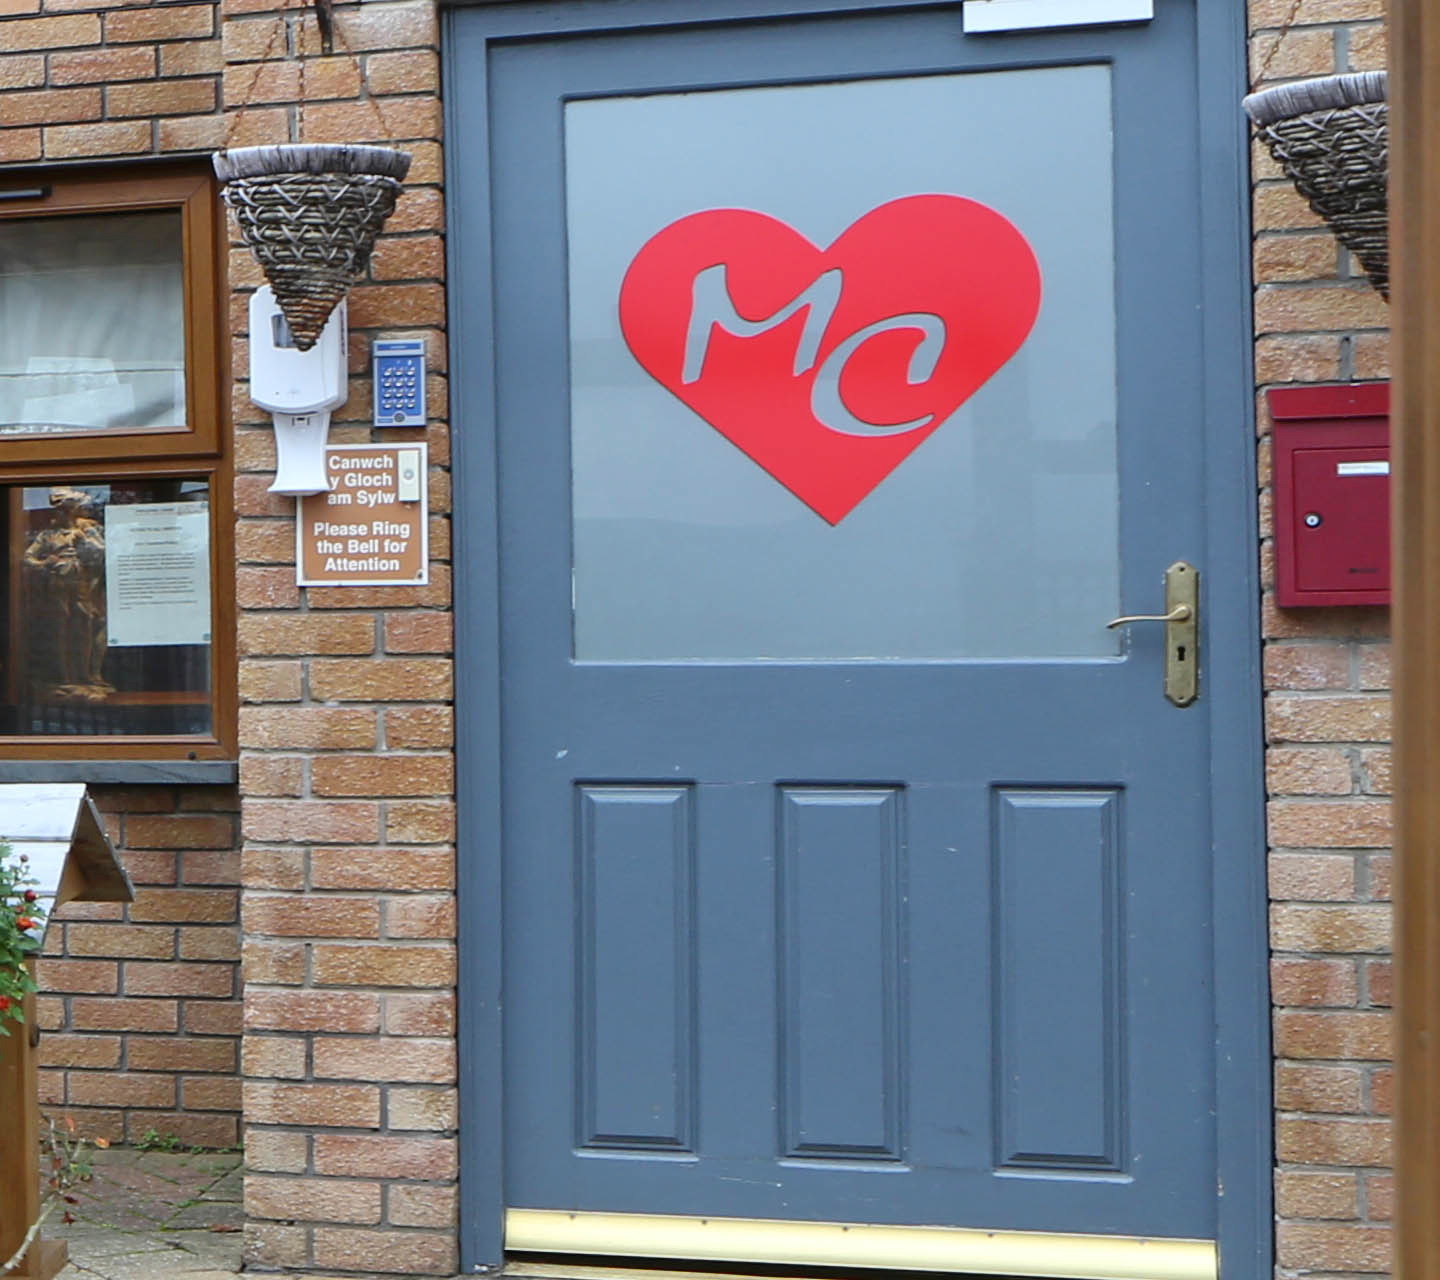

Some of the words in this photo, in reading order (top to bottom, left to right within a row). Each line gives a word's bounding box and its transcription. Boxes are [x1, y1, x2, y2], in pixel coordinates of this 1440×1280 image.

[328, 455, 393, 469] Canwch
[330, 476, 340, 490] y
[344, 472, 392, 487] Gloch
[327, 493, 352, 505] am
[356, 490, 396, 508] Sylw
[314, 522, 368, 536] Please
[372, 521, 410, 538] Ring
[316, 540, 343, 554] the
[348, 539, 379, 553] Bell
[383, 539, 408, 553] for
[324, 557, 400, 572] Attention
